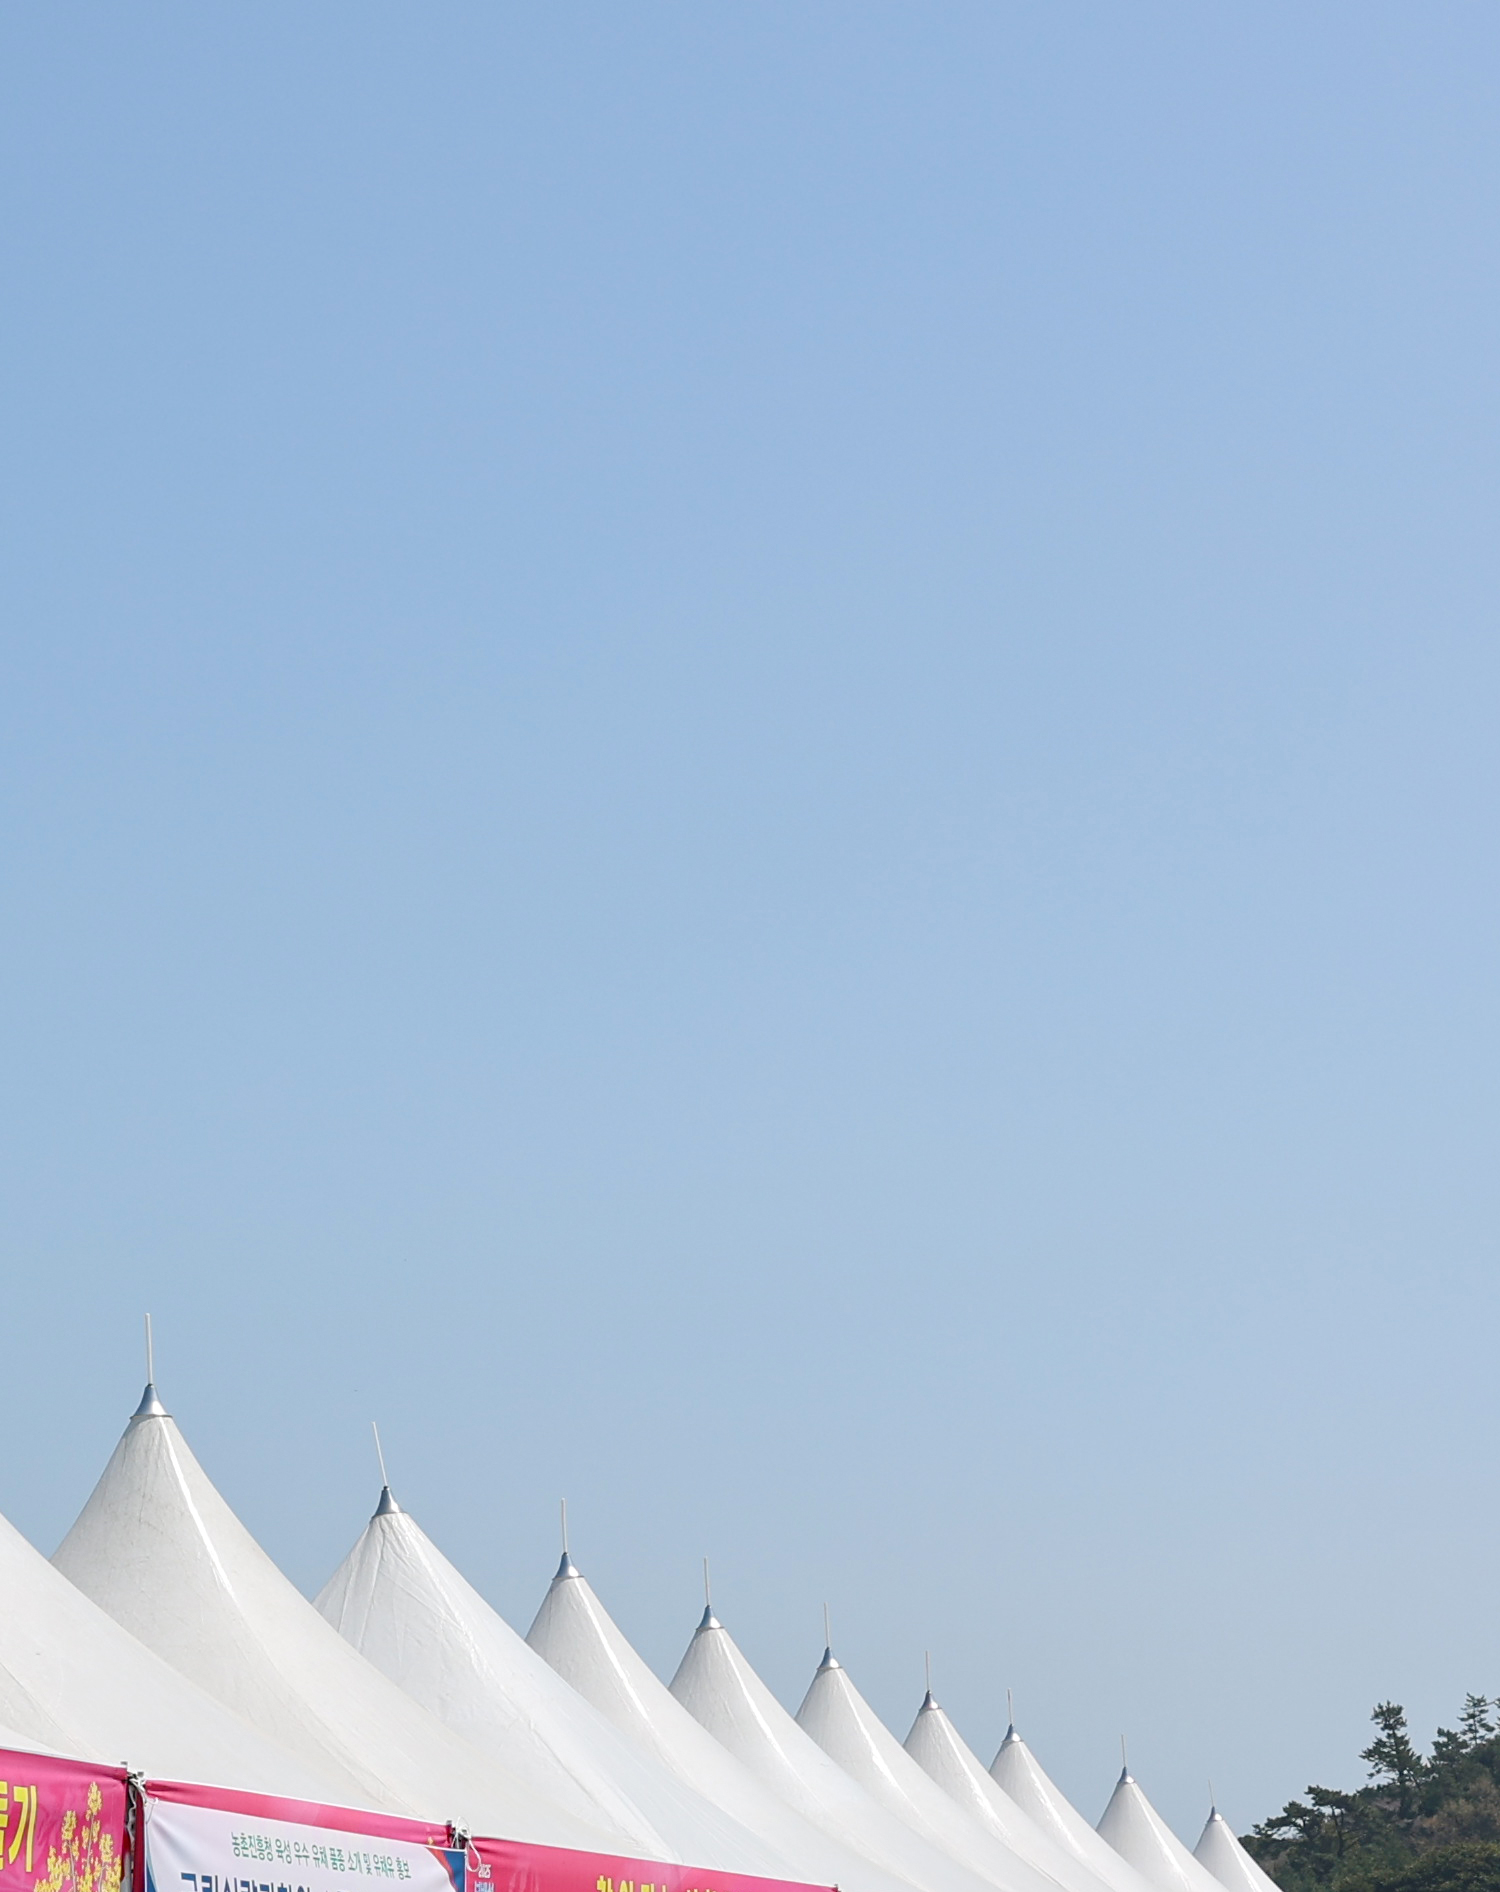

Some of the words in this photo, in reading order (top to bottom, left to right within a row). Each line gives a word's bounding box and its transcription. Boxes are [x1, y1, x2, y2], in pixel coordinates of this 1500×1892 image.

[231, 1832, 273, 1862] 농촌진흥청
[275, 1838, 292, 1865] 육성
[293, 1842, 310, 1867] 우수
[311, 1845, 329, 1869] 유채
[329, 1847, 345, 1872] 품종
[348, 1850, 362, 1874] 소개
[362, 1853, 372, 1875] 및
[372, 1854, 395, 1879] 유채유
[395, 1856, 412, 1881] 홍보
